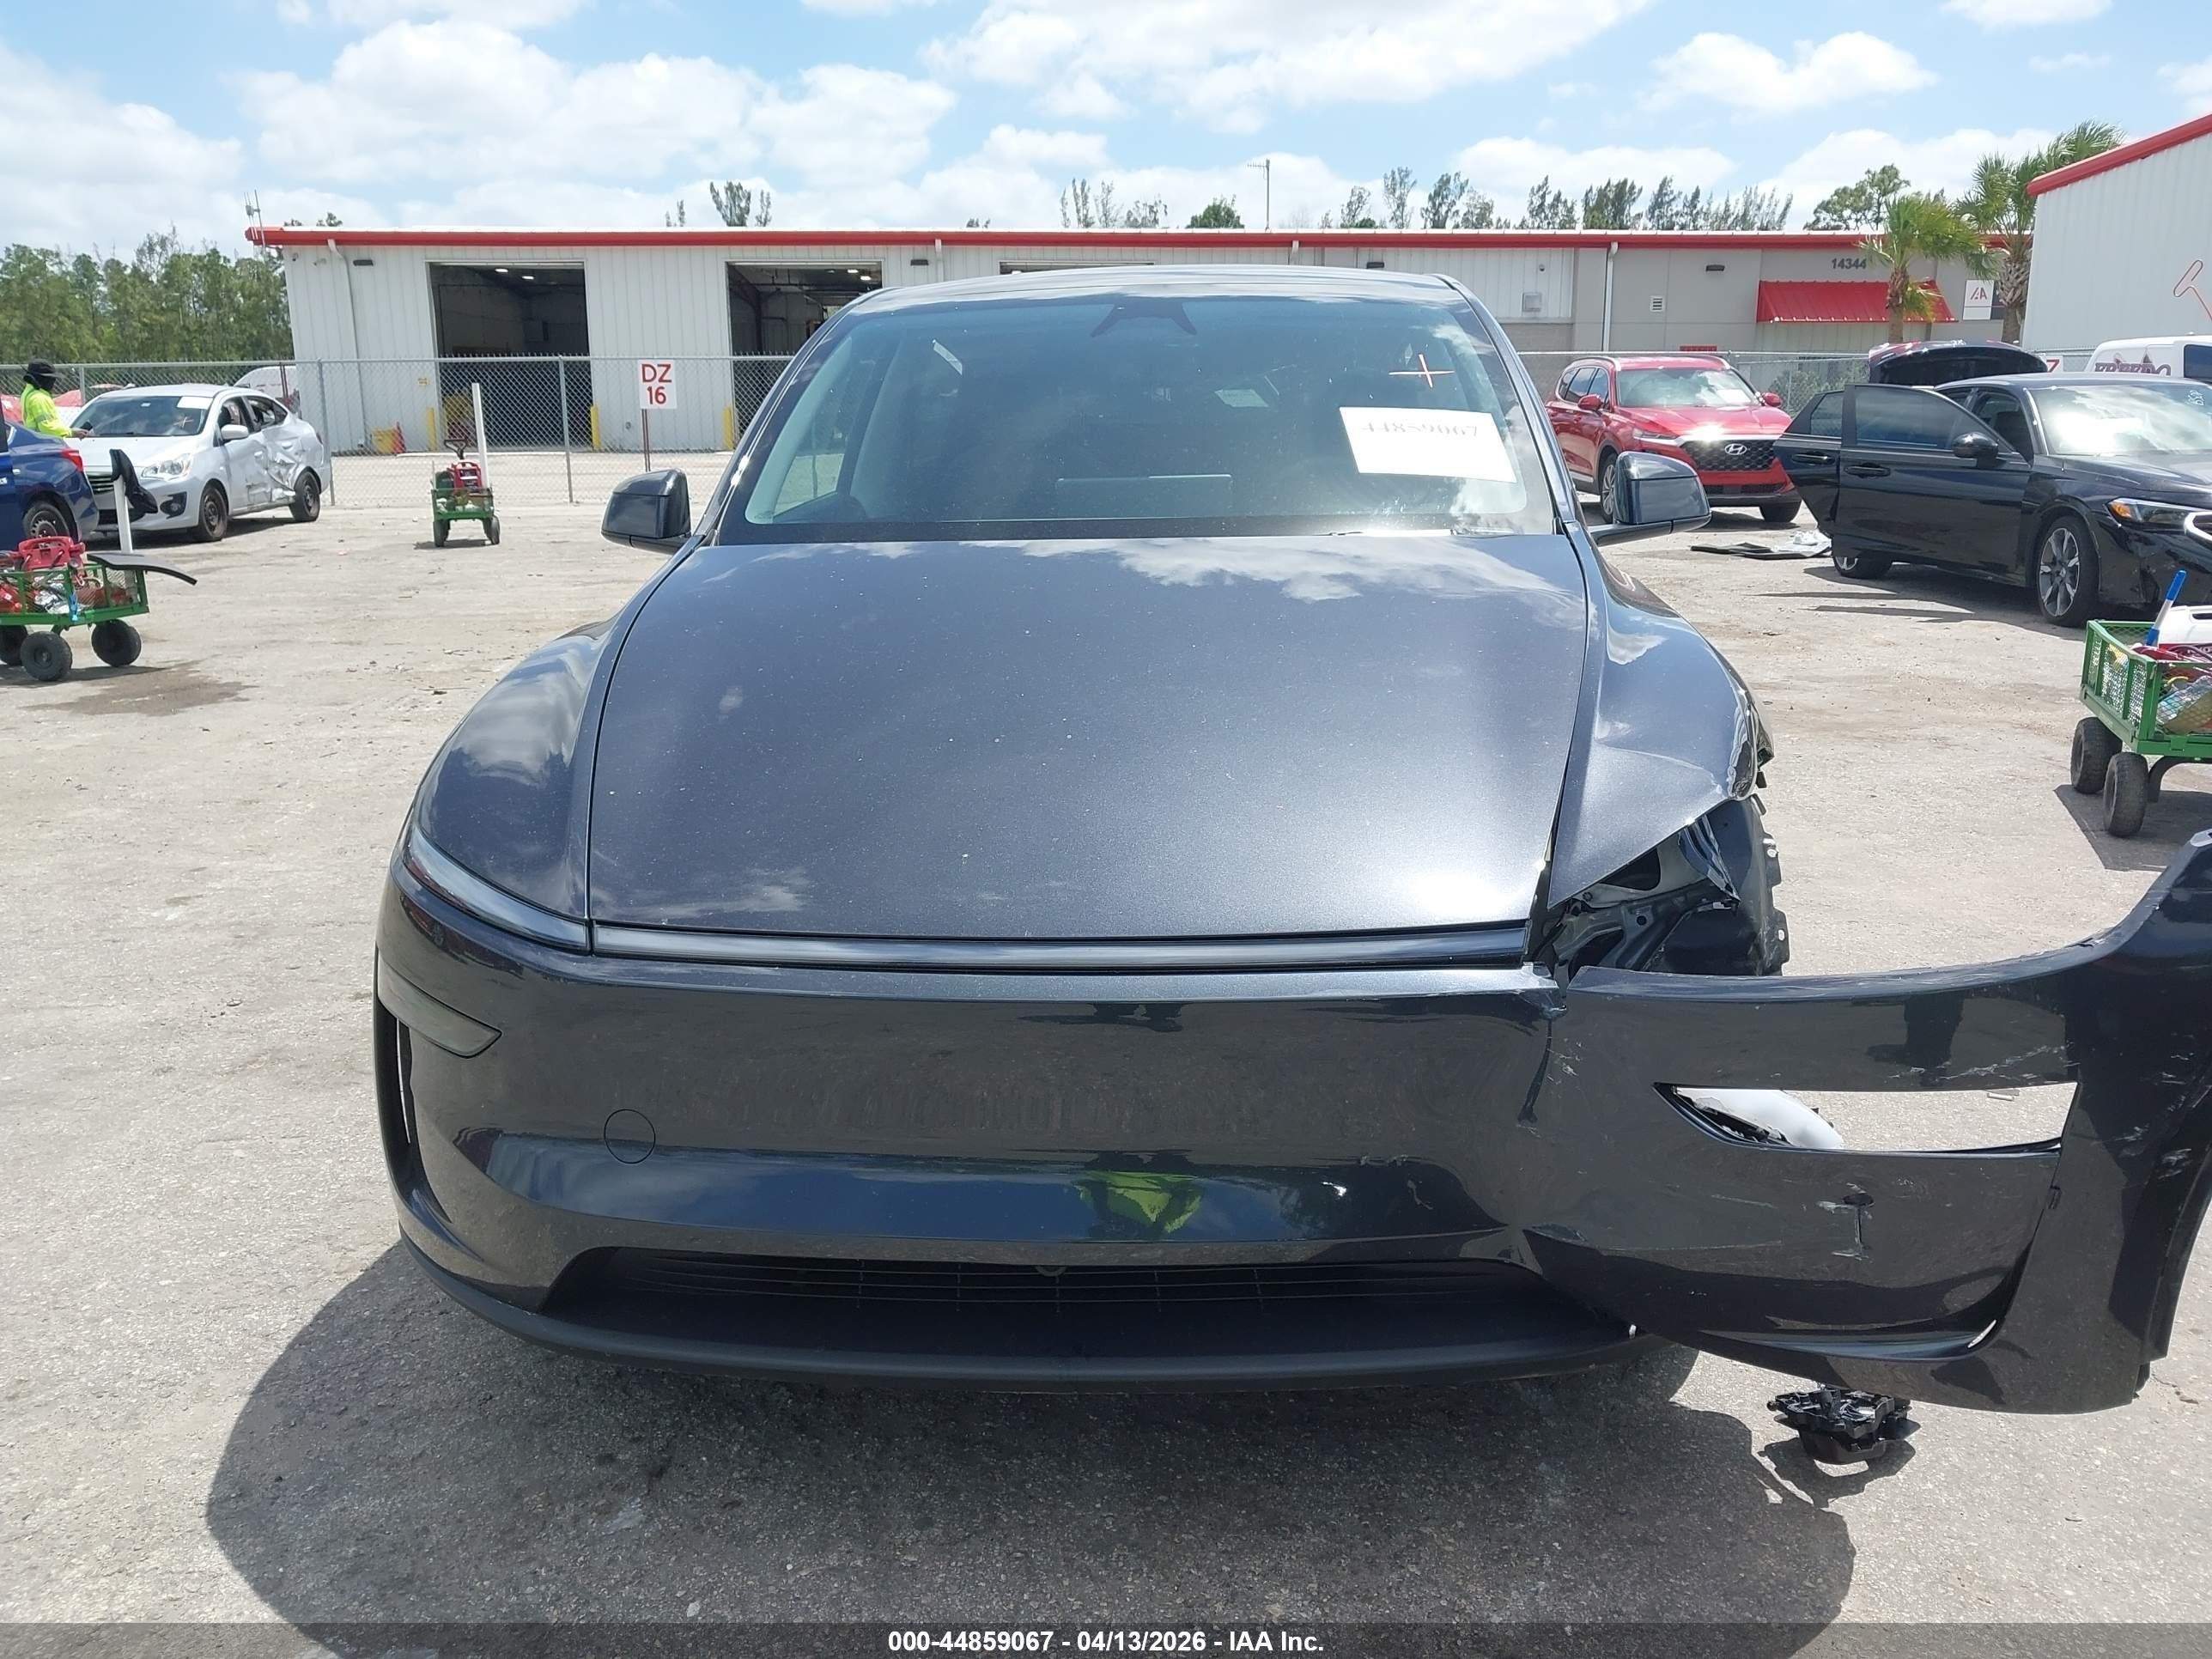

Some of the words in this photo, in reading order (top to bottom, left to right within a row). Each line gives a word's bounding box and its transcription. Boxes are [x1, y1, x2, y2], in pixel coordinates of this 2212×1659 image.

[1831, 258, 1867, 270] 14344
[641, 363, 672, 383] DZ
[647, 386, 667, 405] 16
